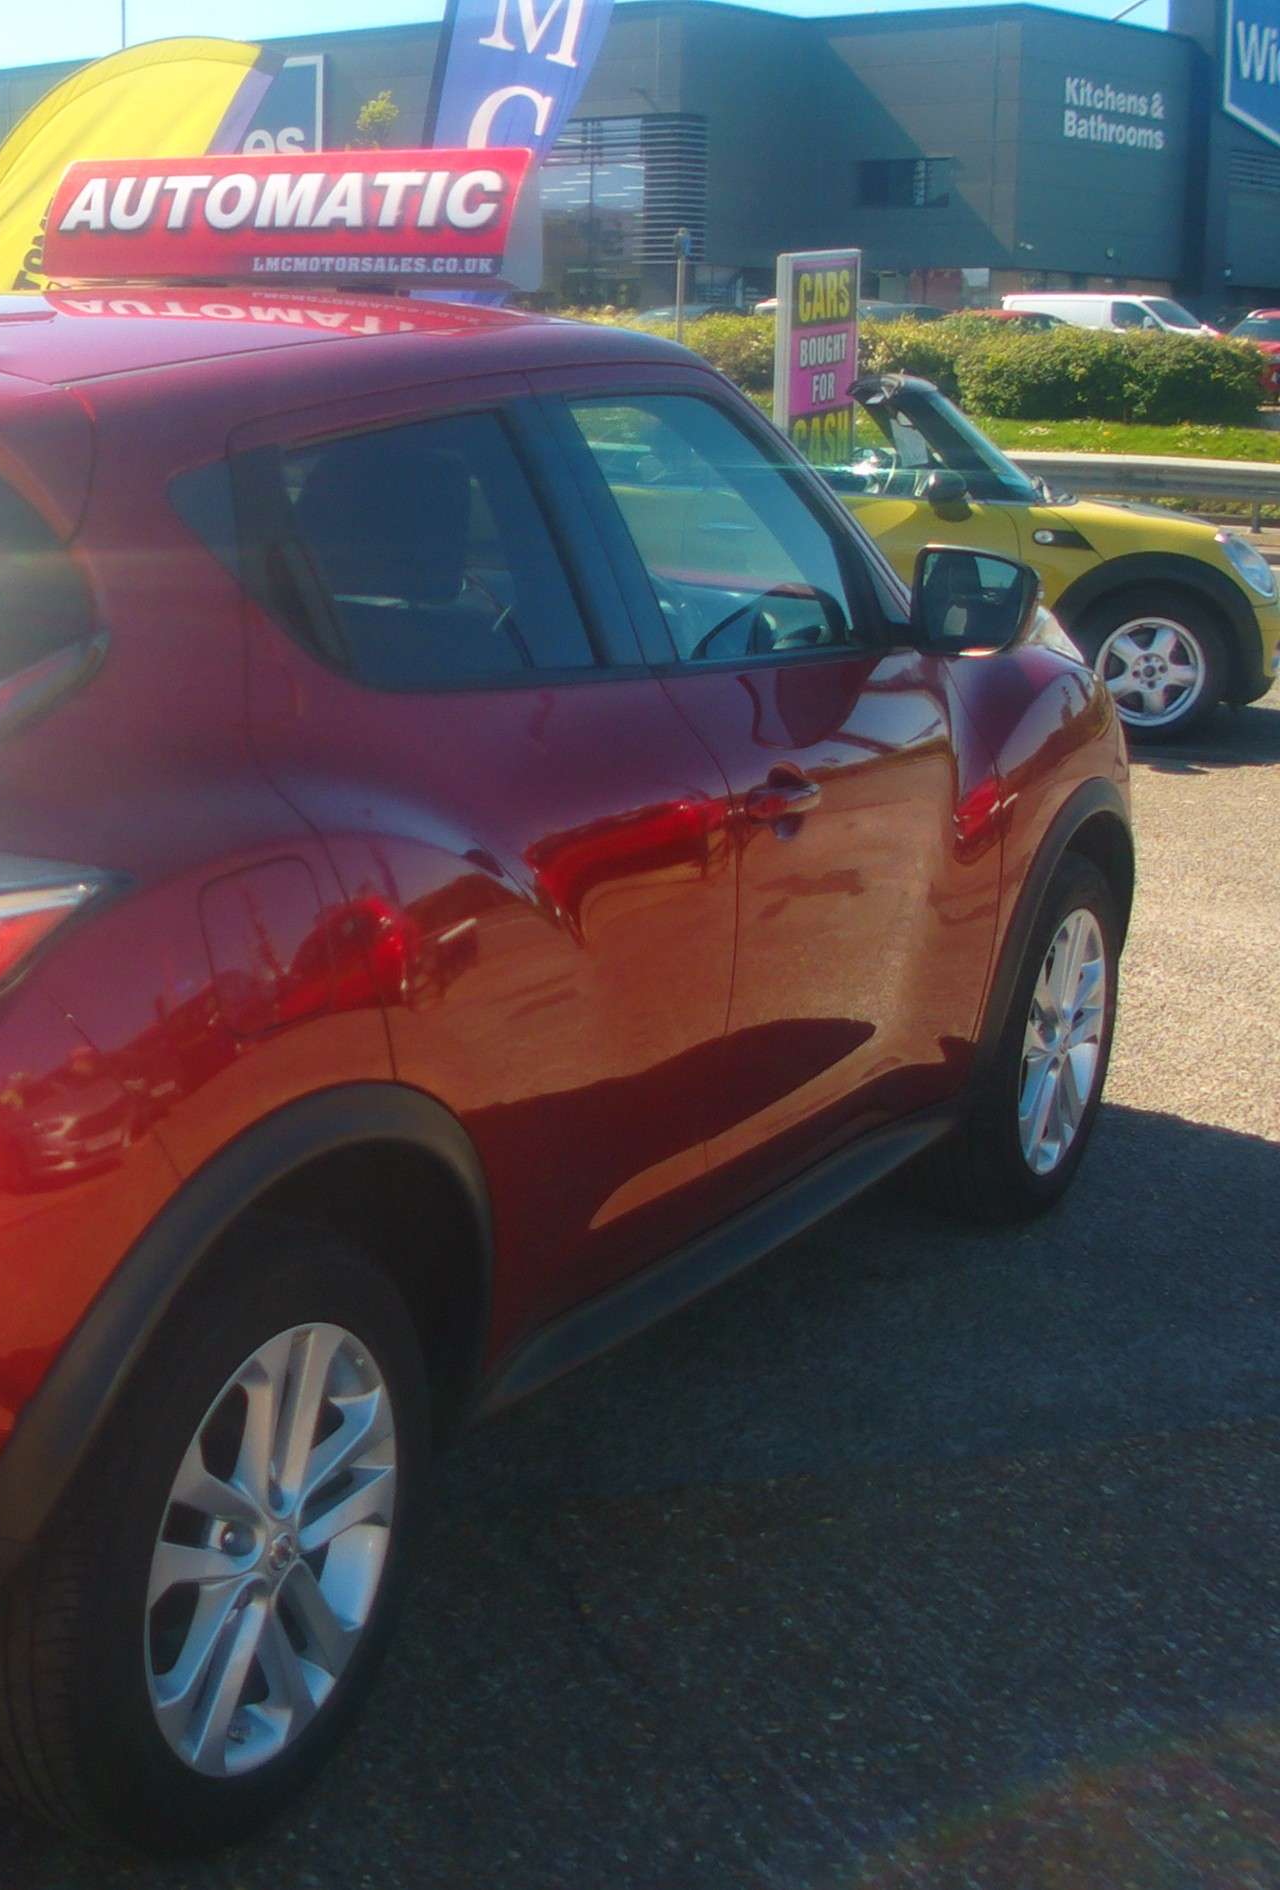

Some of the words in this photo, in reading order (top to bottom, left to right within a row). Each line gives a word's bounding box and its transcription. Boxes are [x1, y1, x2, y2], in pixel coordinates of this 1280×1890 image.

[1235, 20, 1280, 84] Wi
[1065, 77, 1148, 117] Kitchens
[1151, 92, 1164, 119] &
[1064, 109, 1164, 150] Bathrooms
[58, 169, 503, 231] AUTOMATIC
[252, 256, 493, 274] LMCMOTORSALES.CO.UK
[799, 270, 850, 322] CARS
[799, 332, 848, 369] BOUGHT
[811, 371, 836, 403] FOR
[791, 410, 850, 464] CASH
